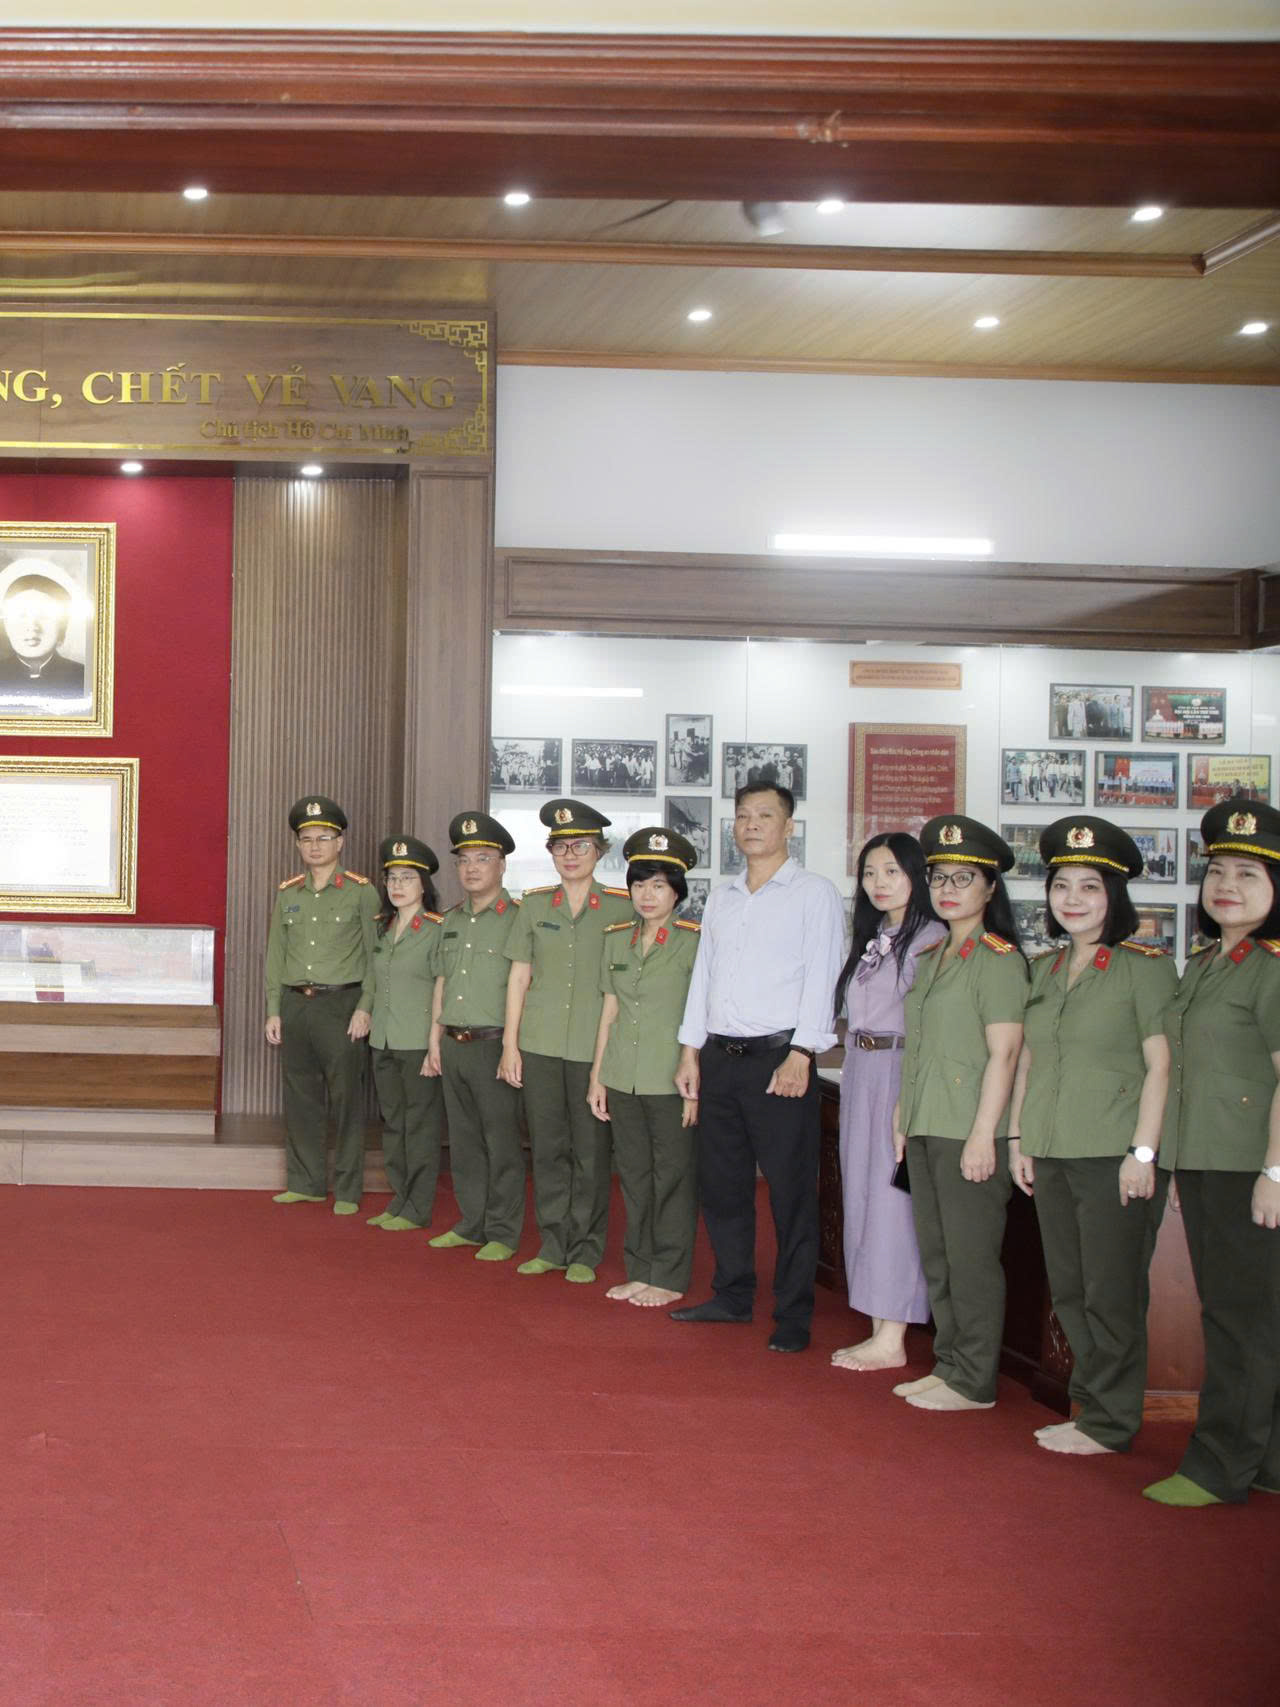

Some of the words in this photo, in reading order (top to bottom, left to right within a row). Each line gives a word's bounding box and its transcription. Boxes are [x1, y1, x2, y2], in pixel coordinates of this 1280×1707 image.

[81, 362, 221, 405] CHẾT
[244, 363, 309, 407] VẺ
[329, 374, 457, 410] VANG
